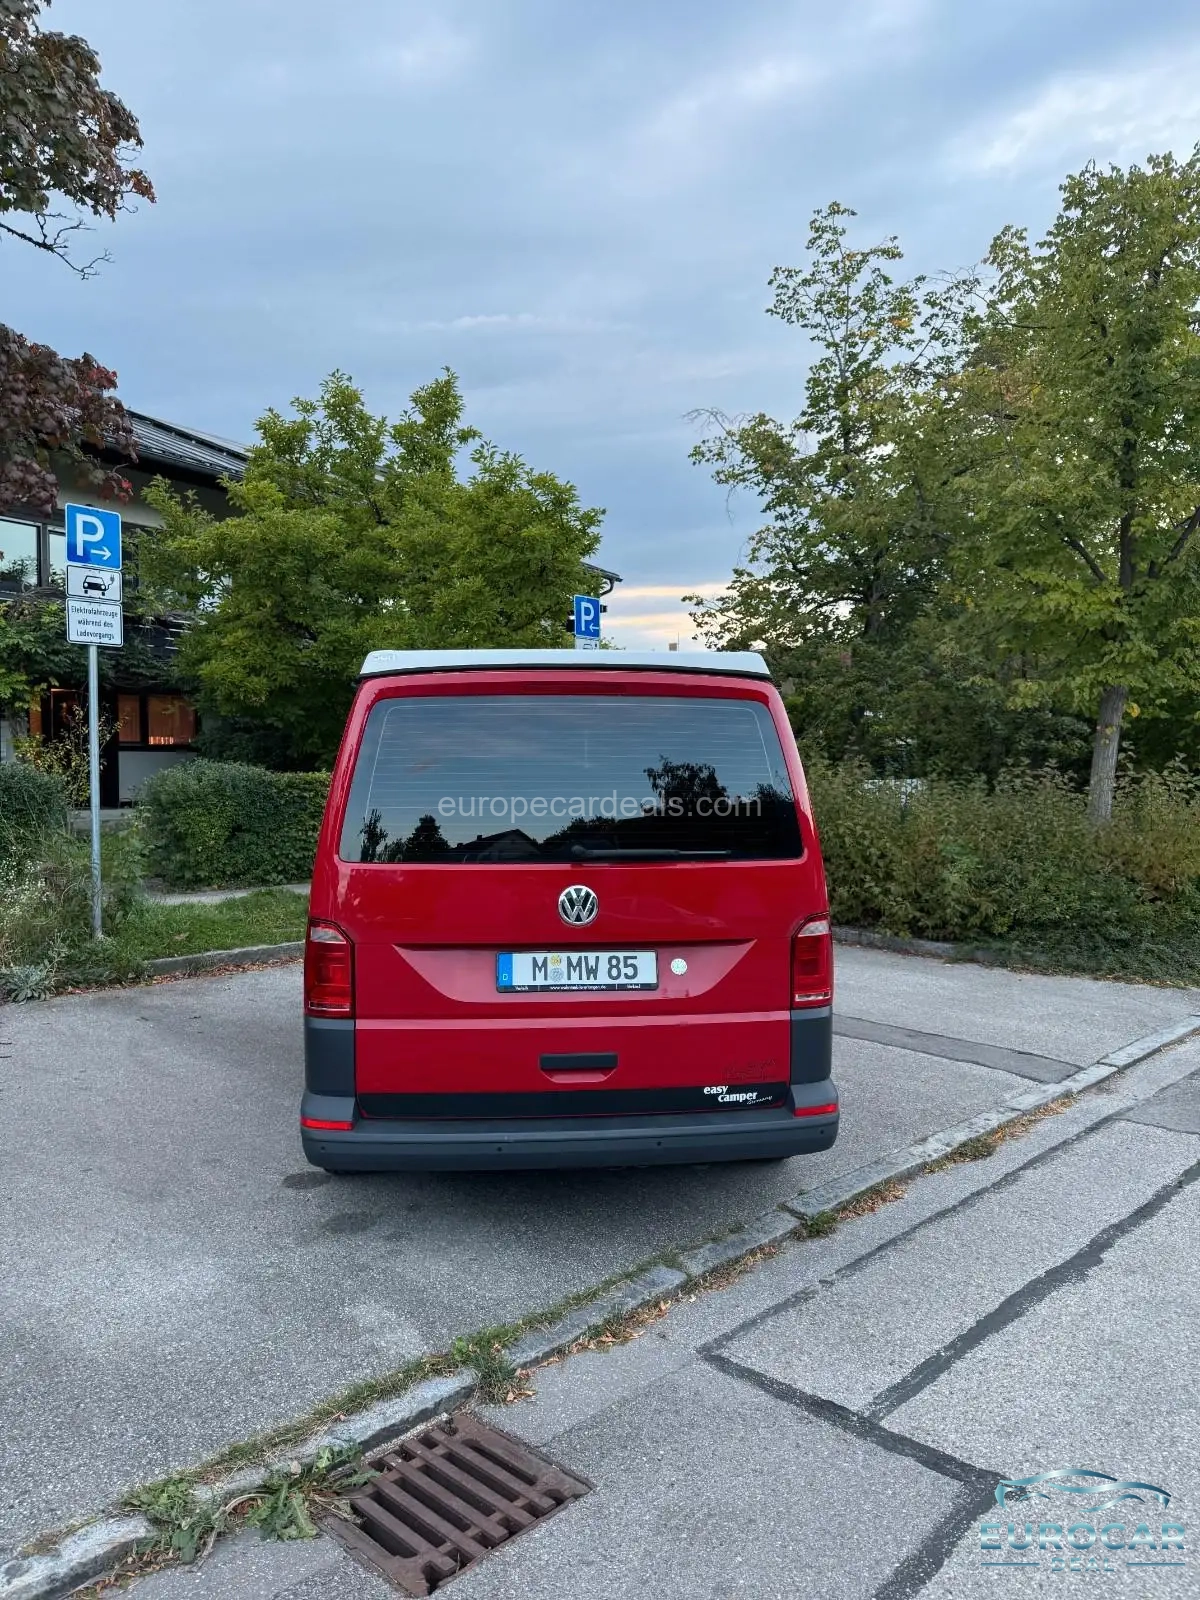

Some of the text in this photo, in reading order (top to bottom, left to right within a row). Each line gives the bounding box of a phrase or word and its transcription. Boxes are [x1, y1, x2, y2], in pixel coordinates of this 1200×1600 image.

[75, 512, 105, 557] P
[71, 605, 118, 618] Elektrofahrzeuge
[580, 601, 595, 632] P
[77, 618, 102, 627] während
[76, 629, 115, 641] Ladevorgangs
[532, 955, 639, 981] M MW 85
[703, 1085, 729, 1095] easy
[717, 1091, 758, 1103] camper
